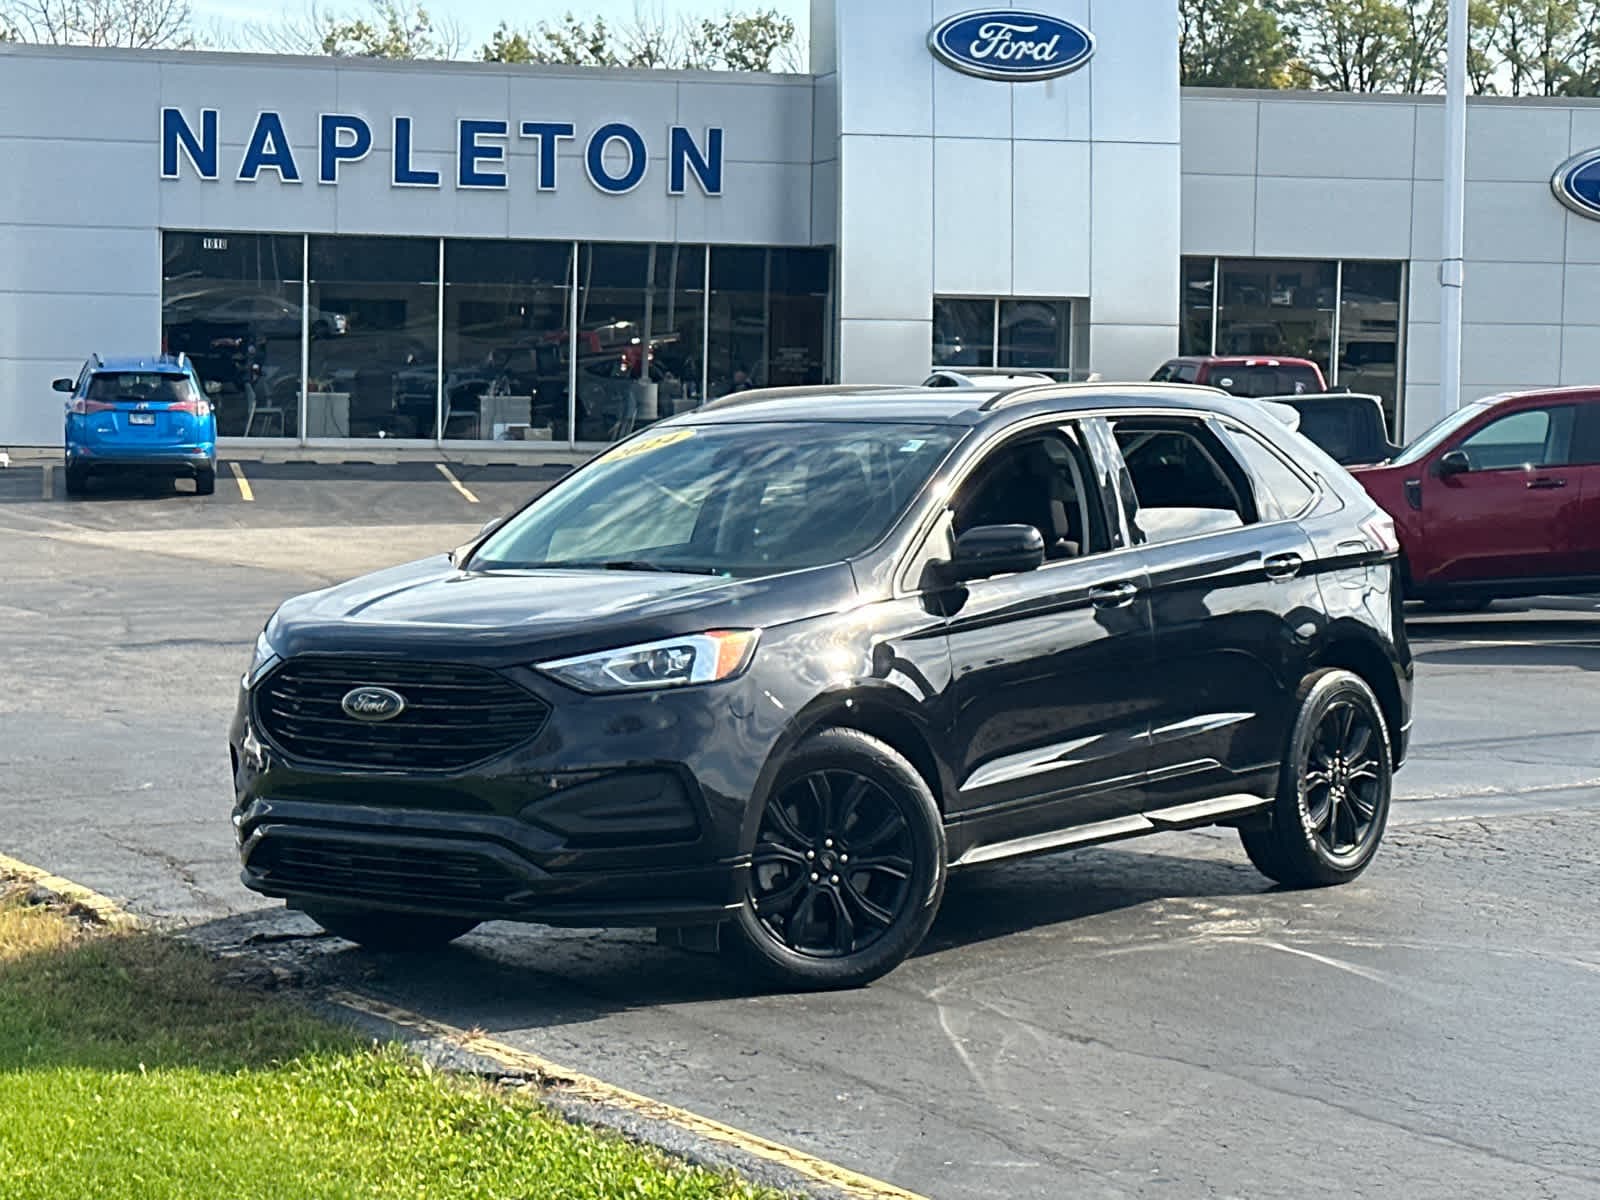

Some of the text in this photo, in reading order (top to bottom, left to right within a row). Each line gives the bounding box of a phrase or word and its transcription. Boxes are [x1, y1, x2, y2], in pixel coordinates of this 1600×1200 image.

[970, 22, 1060, 61] Ford
[160, 106, 724, 196] NAPLETON
[353, 692, 389, 713] Ford
